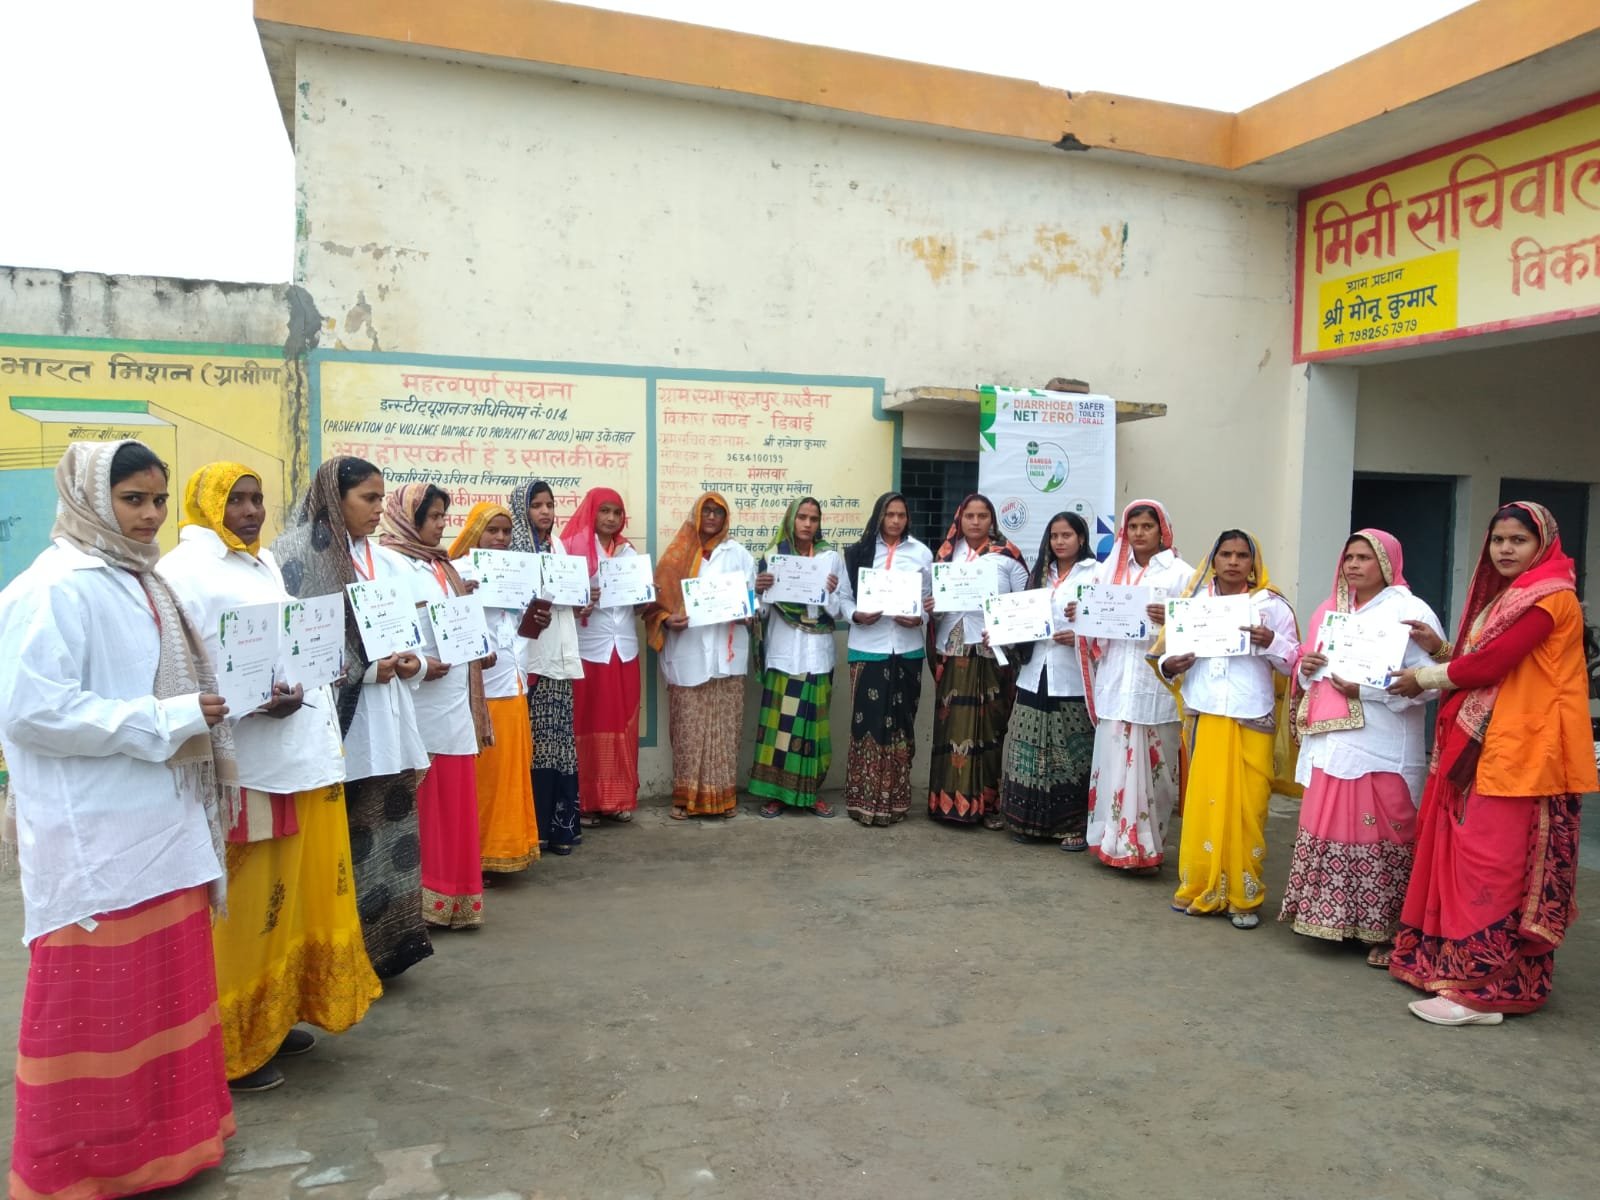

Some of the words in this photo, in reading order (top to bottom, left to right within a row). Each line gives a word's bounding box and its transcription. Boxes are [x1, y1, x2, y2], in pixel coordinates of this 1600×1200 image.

[1313, 182, 1402, 274] मिनी
[1323, 298, 1344, 329] श्री
[1348, 295, 1382, 322] मोनू
[1387, 284, 1438, 319] कुमार
[108, 353, 194, 384] मिशन
[1014, 399, 1074, 411] DIARRHOEA
[1079, 401, 1105, 411] SAFER
[1014, 410, 1038, 422] NET
[1041, 411, 1074, 423] ZERO
[1079, 410, 1105, 418] TOILETS
[385, 422, 398, 434] OF
[399, 423, 440, 436] VIOLENCE
[475, 426, 488, 438] TO
[528, 429, 546, 441] ACT
